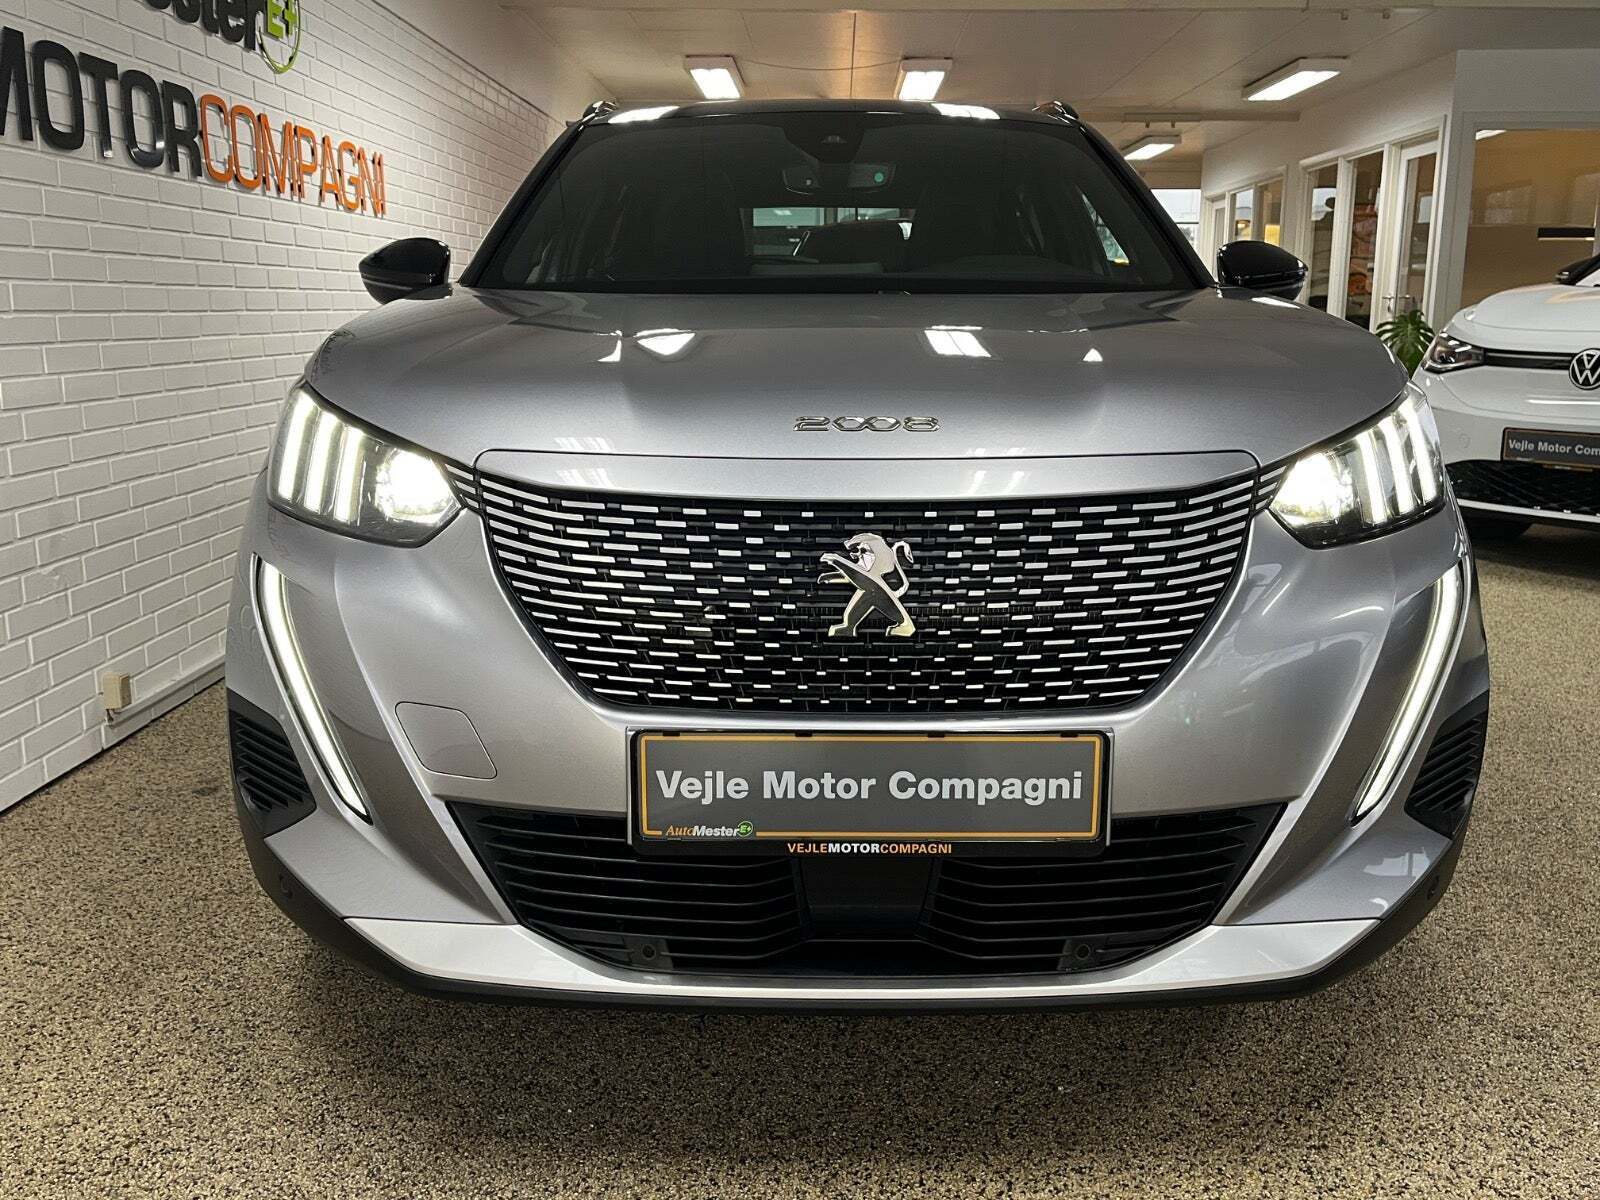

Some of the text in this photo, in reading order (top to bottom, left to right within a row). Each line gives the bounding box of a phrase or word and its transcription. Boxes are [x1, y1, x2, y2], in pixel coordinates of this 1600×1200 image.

[793, 415, 940, 432] 2008
[1508, 440, 1535, 452] Vejle
[1537, 441, 1572, 454] Motor
[656, 770, 1082, 805] Vejle Motor Compagni
